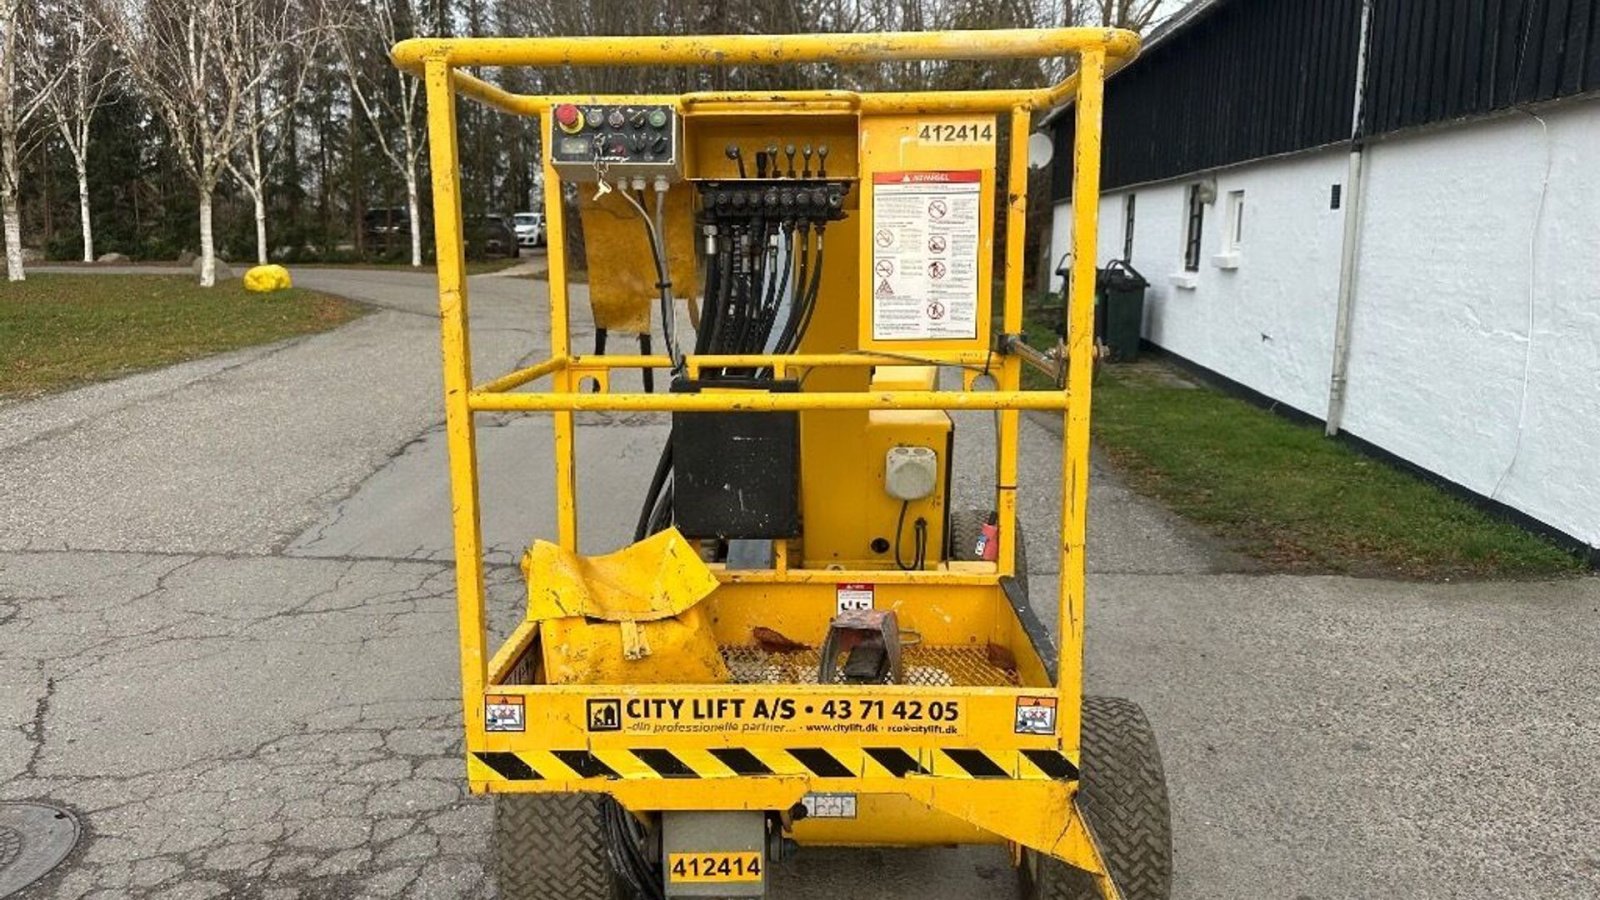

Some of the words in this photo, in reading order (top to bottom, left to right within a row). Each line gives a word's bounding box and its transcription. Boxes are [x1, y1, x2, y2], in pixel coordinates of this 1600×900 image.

[919, 124, 993, 142] 412414
[626, 699, 685, 719] CITY
[692, 698, 746, 720] LIFT
[753, 697, 796, 721] A/S
[821, 699, 852, 720] 43
[859, 699, 885, 720] 71
[892, 700, 923, 721] 42
[928, 701, 959, 721] 05
[653, 722, 739, 734] professionelle
[806, 723, 878, 734] www.citylift.dk
[672, 857, 761, 877] 412414
